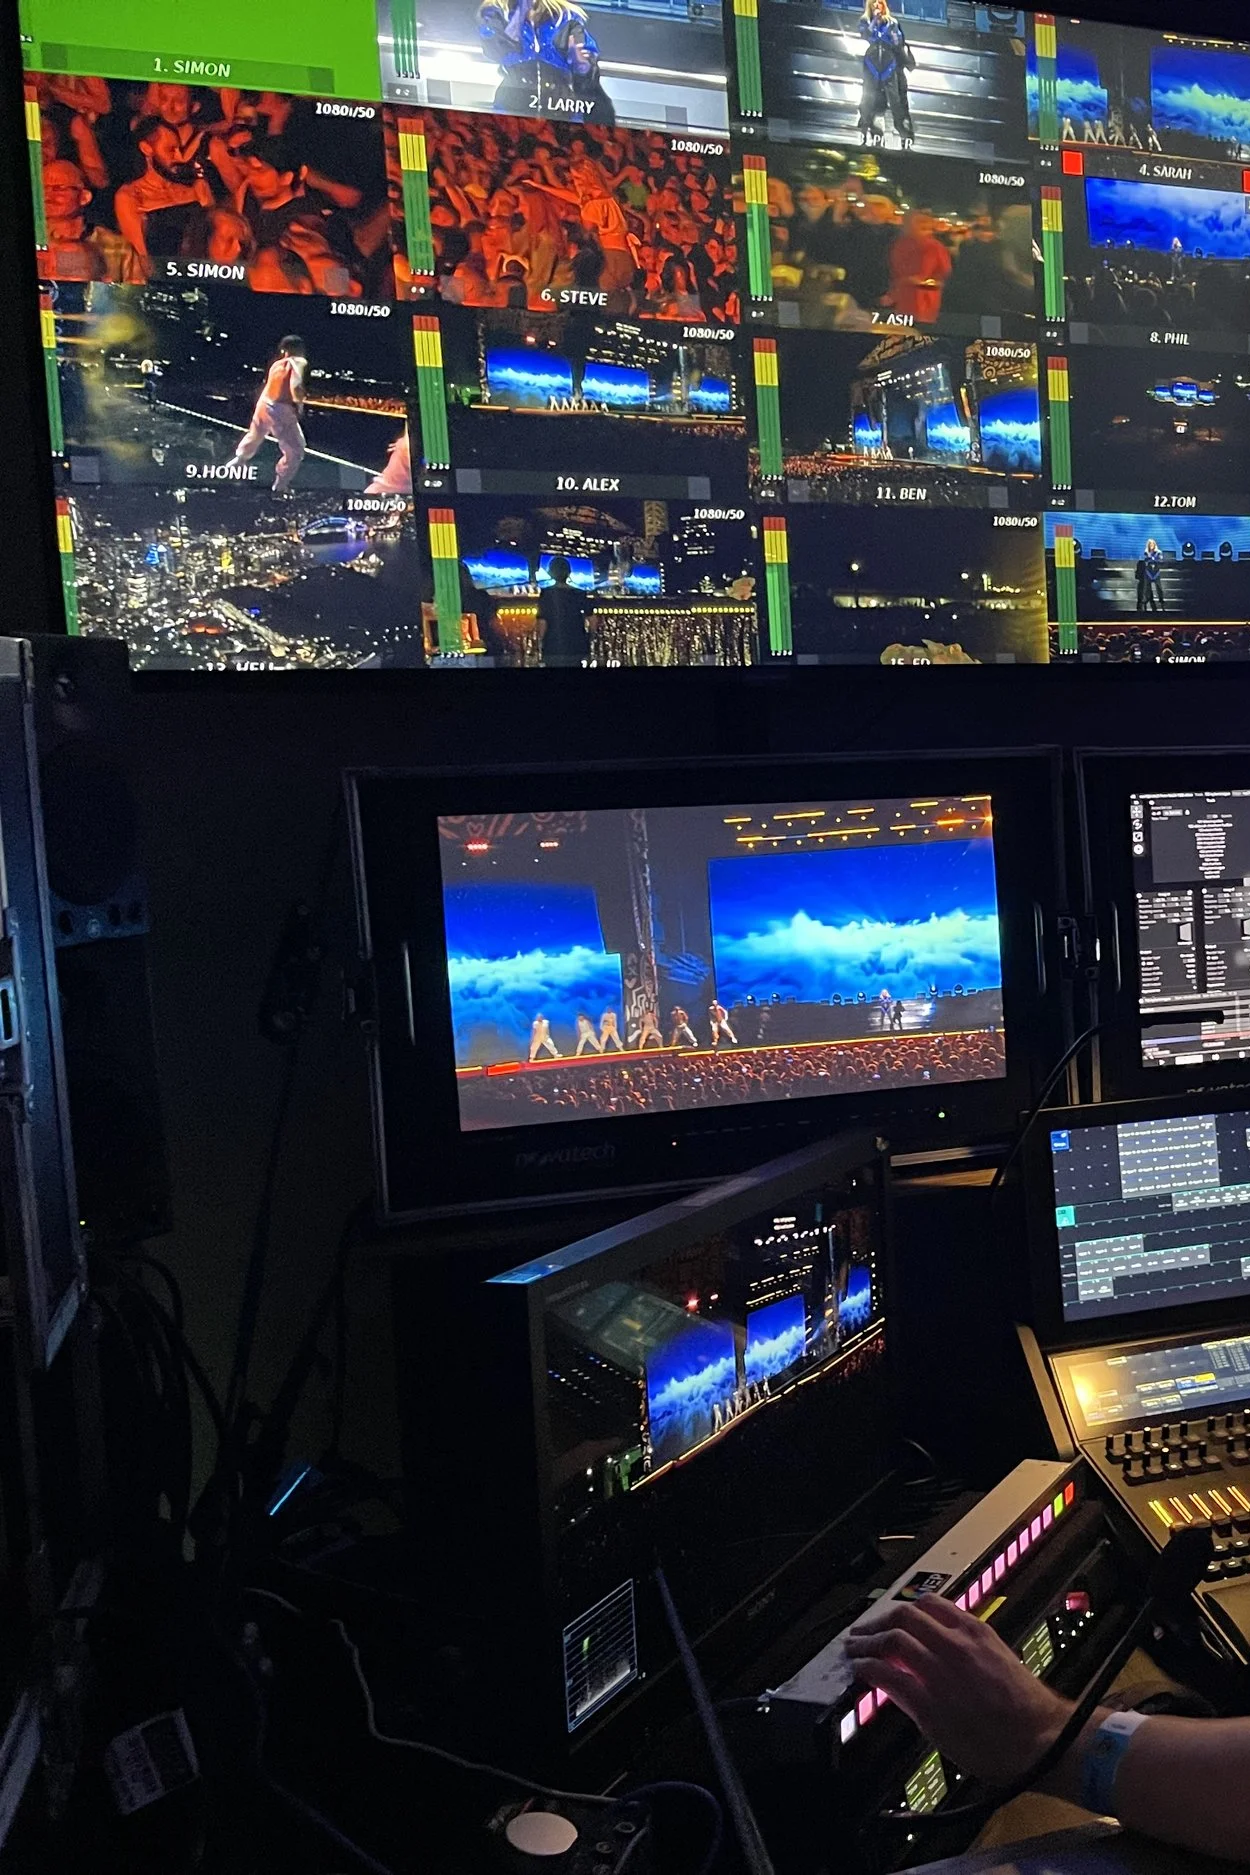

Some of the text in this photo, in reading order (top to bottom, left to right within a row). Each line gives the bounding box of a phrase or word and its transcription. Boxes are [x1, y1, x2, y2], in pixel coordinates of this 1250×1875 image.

[153, 58, 231, 79] 1. SIMON
[529, 95, 595, 114] 2. LARRY
[1139, 164, 1192, 180] 4. SARAH
[167, 261, 244, 280] 5. SIMON
[541, 289, 608, 306] 6. STEVE
[871, 311, 914, 326] 7. ASH
[1150, 331, 1189, 346] 8. PHIL
[556, 476, 620, 492] 10. ALEX
[876, 486, 927, 501] 11. BEN
